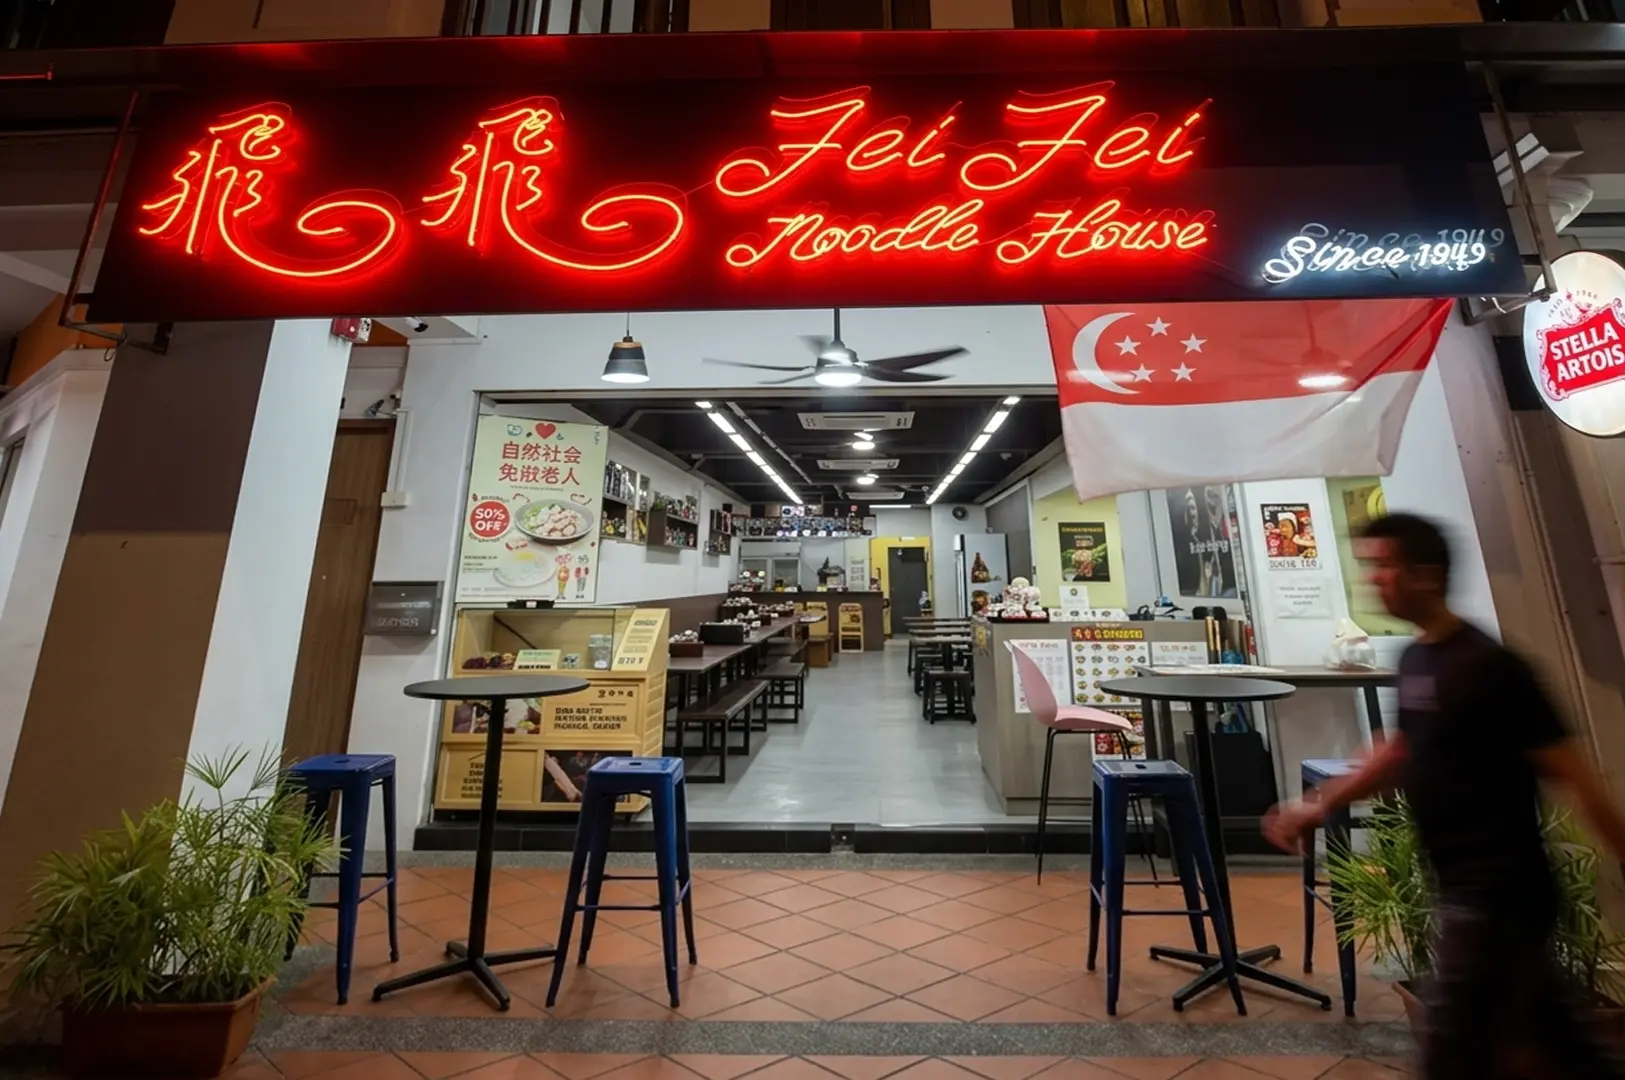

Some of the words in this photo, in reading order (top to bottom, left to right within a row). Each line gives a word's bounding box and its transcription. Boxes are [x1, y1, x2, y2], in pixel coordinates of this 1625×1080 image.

[714, 98, 956, 198] Fei
[959, 94, 1202, 192] Fei
[724, 198, 984, 268] Noodle
[996, 199, 1209, 265] House
[1262, 235, 1410, 284] Since
[1416, 242, 1487, 272] 1949
[1549, 321, 1620, 361] STELLA
[1555, 343, 1625, 383] ARTOIS
[502, 440, 582, 464] 自然社会
